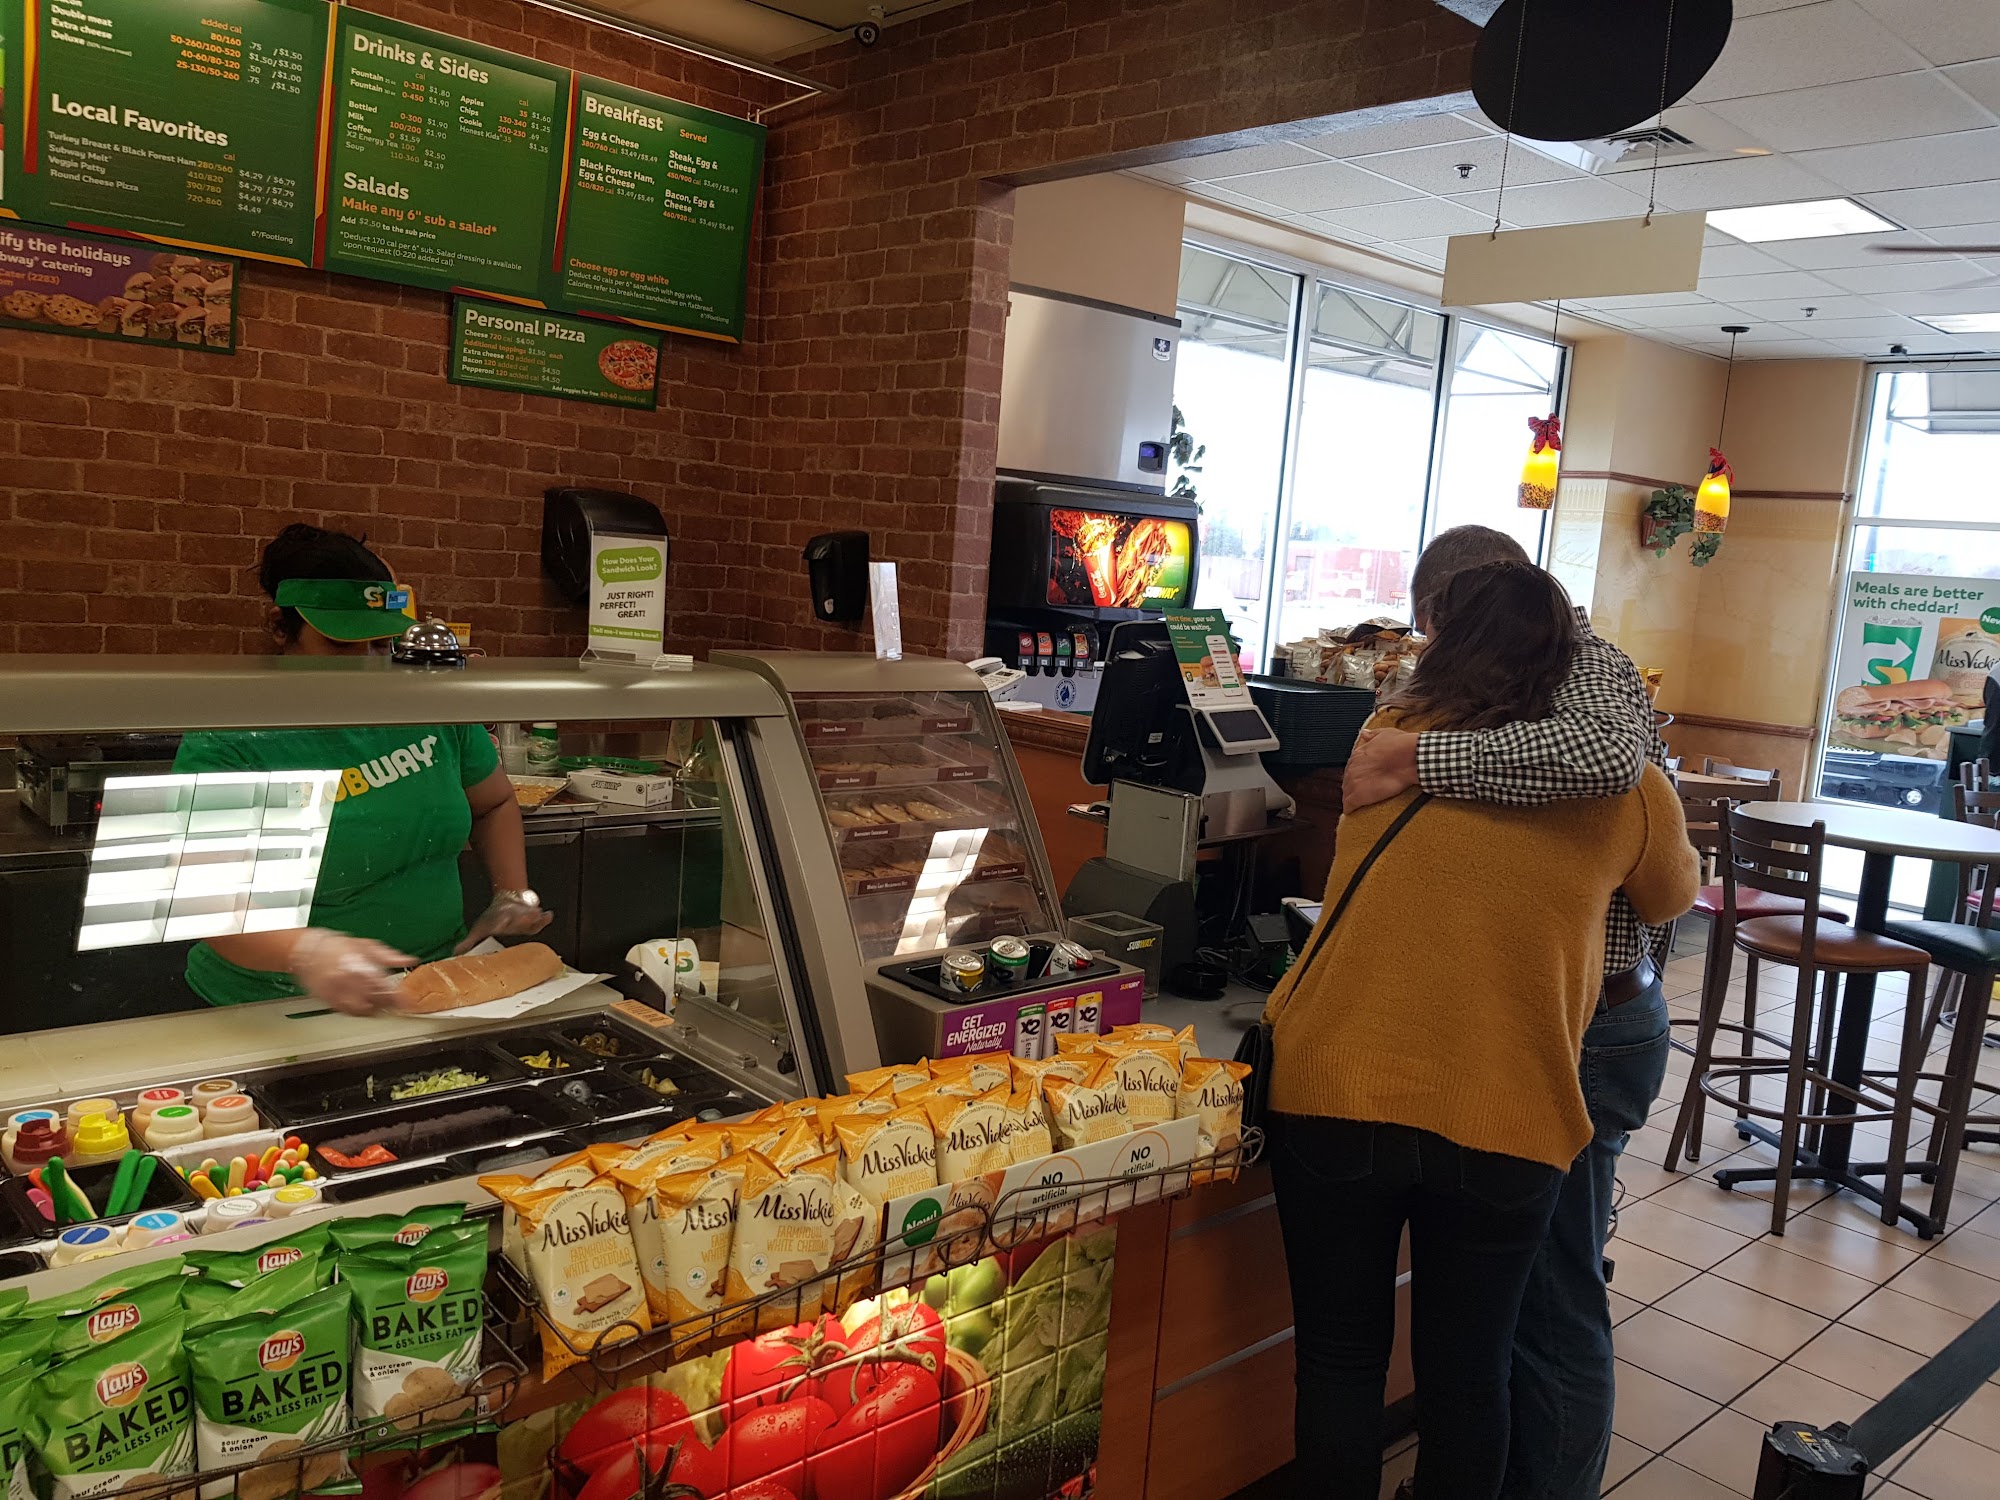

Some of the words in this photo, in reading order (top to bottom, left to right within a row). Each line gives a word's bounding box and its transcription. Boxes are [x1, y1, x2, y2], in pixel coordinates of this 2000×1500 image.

[51, 17, 79, 31] Extra
[80, 25, 113, 39] cheese
[87, 16, 113, 27] meat
[201, 18, 228, 30] added
[230, 26, 242, 34] cal
[51, 29, 85, 45] Deluxe
[210, 33, 242, 46] 80/160
[354, 34, 416, 66] Drinks
[421, 51, 434, 71] &
[440, 57, 489, 84] Sides
[351, 68, 384, 82] Fountain
[351, 79, 383, 93] Fountain
[349, 101, 378, 113] Bottled
[460, 96, 485, 107] Apples
[51, 93, 118, 124] Local
[124, 108, 229, 147] Favorites
[348, 112, 365, 121] Milk
[460, 106, 479, 117] Chips
[585, 96, 664, 132] Breakfast
[347, 123, 372, 134] Coffee
[459, 116, 483, 128] Cookie
[460, 125, 486, 137] Honest
[583, 128, 600, 141] Egg
[610, 135, 640, 150] Cheese
[680, 129, 707, 143] Served
[47, 130, 80, 145] Turkey
[81, 137, 111, 151] Breast
[122, 146, 147, 158] Black
[148, 150, 176, 163] Forest
[177, 157, 197, 167] Ham
[346, 141, 365, 152] Soup
[359, 134, 384, 147] Energy
[49, 144, 86, 160] Subway
[669, 150, 694, 165] Steak,
[696, 157, 711, 170] Egg
[48, 155, 79, 168] Veggie
[80, 162, 106, 175] Patty
[580, 158, 604, 171] Black
[606, 165, 632, 178] Forest
[634, 171, 655, 185] Ham,
[668, 161, 697, 174] Cheese
[50, 169, 81, 182] Round
[82, 175, 115, 188] Cheese
[116, 180, 140, 192] Pizza
[344, 172, 410, 200] Salads
[579, 169, 595, 181] Egg
[606, 175, 636, 189] Cheese
[664, 200, 692, 213] Cheese
[665, 189, 692, 204] Bacon,
[693, 196, 708, 209] Egg
[342, 196, 378, 213] Make
[381, 206, 404, 221] any
[424, 215, 446, 227] sub
[449, 220, 457, 229] a
[341, 216, 357, 225] Add
[419, 231, 436, 240] price
[28, 237, 57, 254] the
[62, 242, 131, 268] holidays
[343, 241, 362, 250] upon
[364, 245, 392, 256] request
[418, 254, 440, 264] added
[387, 240, 398, 248] cal
[437, 248, 456, 259] Salad
[457, 253, 485, 265] dressing
[493, 260, 522, 271] available
[0, 251, 34, 268] bway
[42, 261, 93, 277] catering
[570, 258, 601, 272] Choose
[603, 267, 619, 277] egg
[630, 272, 646, 283] egg
[647, 275, 669, 285] white
[465, 329, 488, 339] Cheese
[466, 309, 540, 336] Personal
[544, 322, 586, 344] Pizza
[463, 356, 483, 365] Bacon
[602, 566, 636, 574] Sandwich
[637, 564, 657, 572] Look?
[607, 592, 626, 600] JUST
[627, 591, 654, 599] RIGHT!
[1143, 587, 1179, 599] SUBWAY
[1855, 582, 1900, 595] Meals
[1904, 586, 1929, 597] are
[1933, 586, 1984, 601] better
[600, 601, 636, 610] PERFECT!
[618, 610, 645, 618] GREAT!
[1854, 597, 1887, 609] with
[1891, 599, 1959, 615] cheddar!
[1127, 938, 1155, 951] SUBWAY
[962, 1014, 984, 1030] GET
[1050, 1012, 1070, 1029] X2
[1079, 1007, 1098, 1023] X2
[947, 1022, 1007, 1047] ENERGIZED
[1020, 1019, 1040, 1035] X2
[964, 1036, 1003, 1055] Naturally
[1131, 1146, 1151, 1163] NO
[1122, 1160, 1155, 1176] artificial
[888, 1168, 929, 1189] FARMHOUSE
[1041, 1172, 1063, 1186] NO
[1032, 1186, 1068, 1205] artificial
[799, 1188, 835, 1227] Vickie
[576, 1202, 632, 1235] Vickie
[777, 1225, 823, 1239] FARMHOUSE
[570, 1236, 619, 1261] FARMHOUSE
[767, 1239, 793, 1252] WHITE
[797, 1238, 829, 1252] CHEDDAR
[563, 1260, 590, 1280] WHITE
[592, 1249, 632, 1269] CHEDDAR
[409, 1272, 446, 1295] Lay's
[92, 1307, 136, 1336] Lay's
[372, 1297, 479, 1342] BAKED
[396, 1337, 416, 1350] 65%
[418, 1332, 442, 1345] LESS
[446, 1328, 464, 1341] FAT
[263, 1334, 303, 1363] Lay's
[369, 1365, 387, 1373] sour
[389, 1361, 413, 1370] cream
[378, 1368, 401, 1376] onion
[102, 1367, 145, 1401] Lay's
[222, 1361, 344, 1418] BAKED
[250, 1410, 273, 1425] 65%
[276, 1401, 302, 1419] LESS
[305, 1393, 324, 1409] FAT
[63, 1385, 190, 1465] BAKED
[98, 1449, 121, 1466] 65%
[124, 1432, 151, 1453] LESS
[155, 1420, 174, 1438] FAT
[222, 1440, 240, 1449] sour
[242, 1434, 269, 1446] cream
[230, 1443, 254, 1452] onion
[93, 1474, 121, 1490] cream
